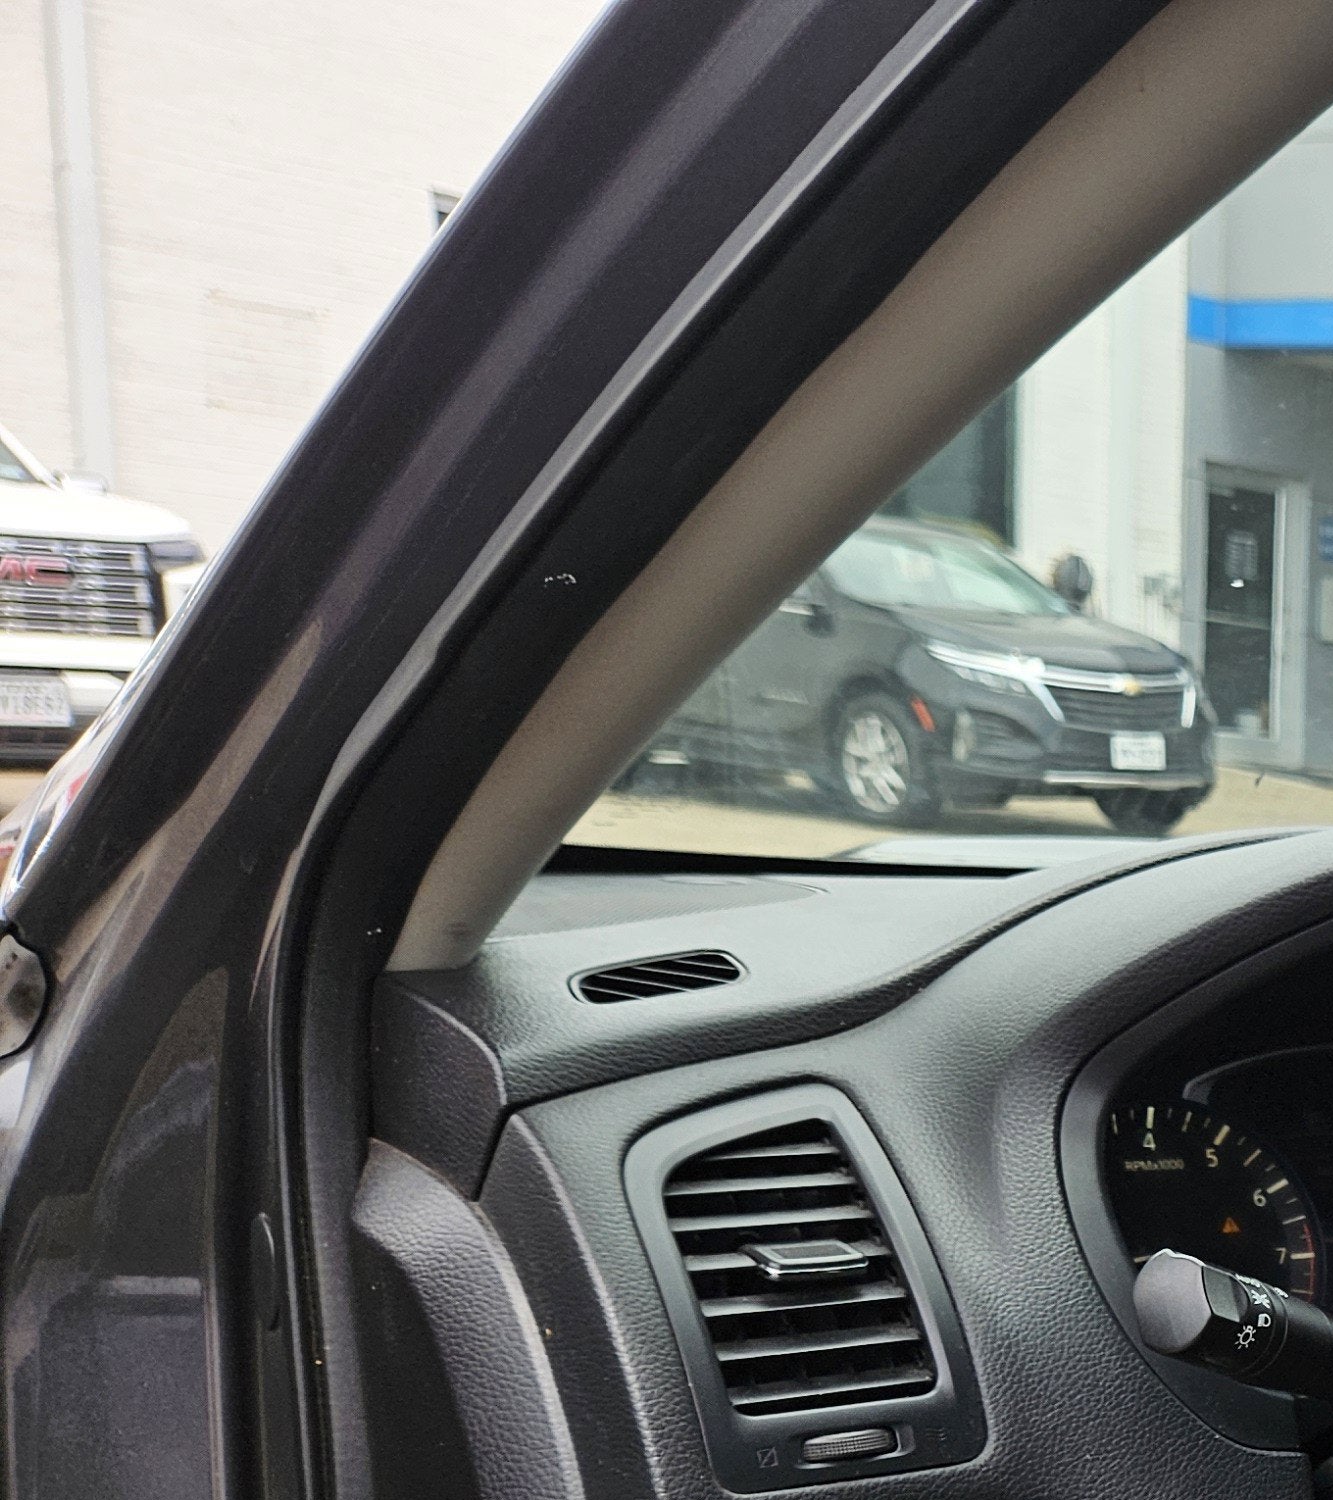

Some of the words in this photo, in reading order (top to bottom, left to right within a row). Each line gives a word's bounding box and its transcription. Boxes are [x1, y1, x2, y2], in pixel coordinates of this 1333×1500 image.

[1142, 1132, 1156, 1151] 4
[1204, 1149, 1219, 1168] 5
[1252, 1188, 1267, 1207] 6
[1275, 1247, 1287, 1265] 7
